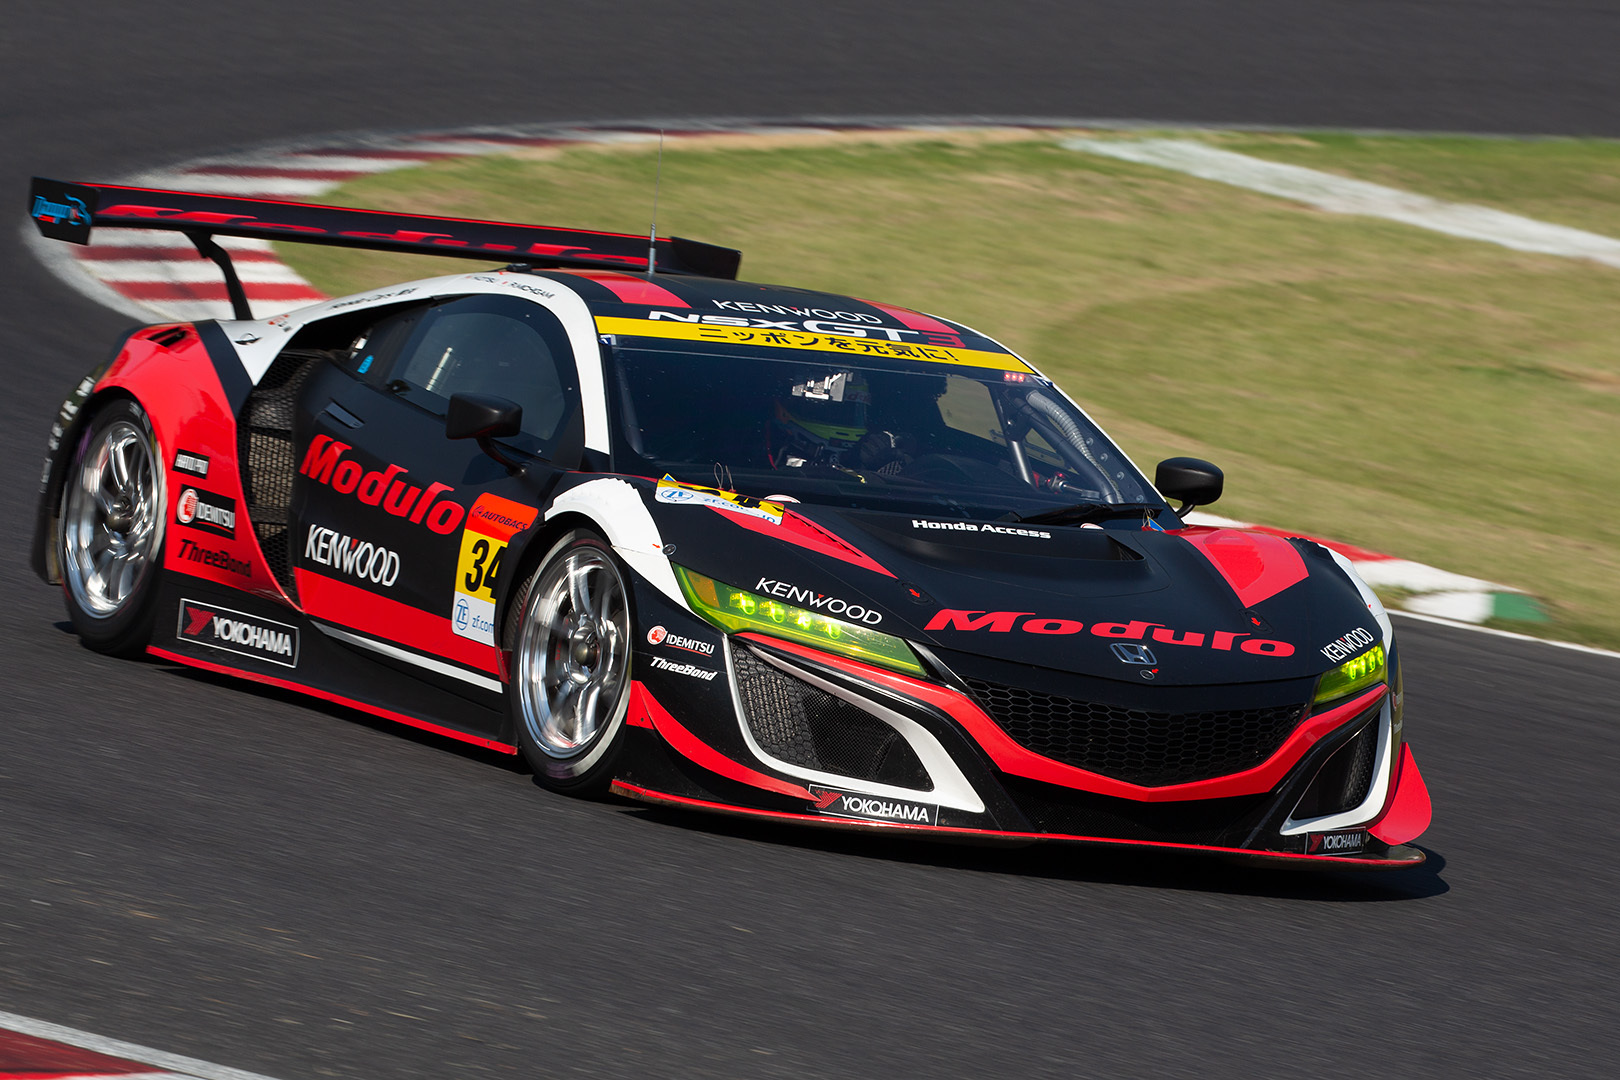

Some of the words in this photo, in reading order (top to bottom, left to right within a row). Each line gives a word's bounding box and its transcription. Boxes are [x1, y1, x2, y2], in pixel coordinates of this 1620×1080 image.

[712, 299, 883, 324] KENWOOD
[299, 433, 466, 535] Modulo
[195, 501, 235, 529] IDEMITSU
[481, 511, 528, 531] AUTOBACS
[912, 519, 978, 533] Honda
[980, 524, 1051, 540] Access
[178, 538, 251, 578] ThreeBond
[304, 524, 401, 587] KENWOOD
[465, 538, 507, 600] 34
[456, 604, 469, 625] ZF
[755, 577, 882, 625] KENWOOD
[212, 615, 292, 657] YOKOHAMA
[666, 633, 715, 654] IDEMITSU
[924, 608, 1295, 657] Modulo
[1320, 627, 1374, 663] KENWOOD
[650, 656, 717, 681] ThreeBond
[841, 796, 929, 822] YOKOHAMA
[1323, 833, 1361, 849] YOKOHAMA
